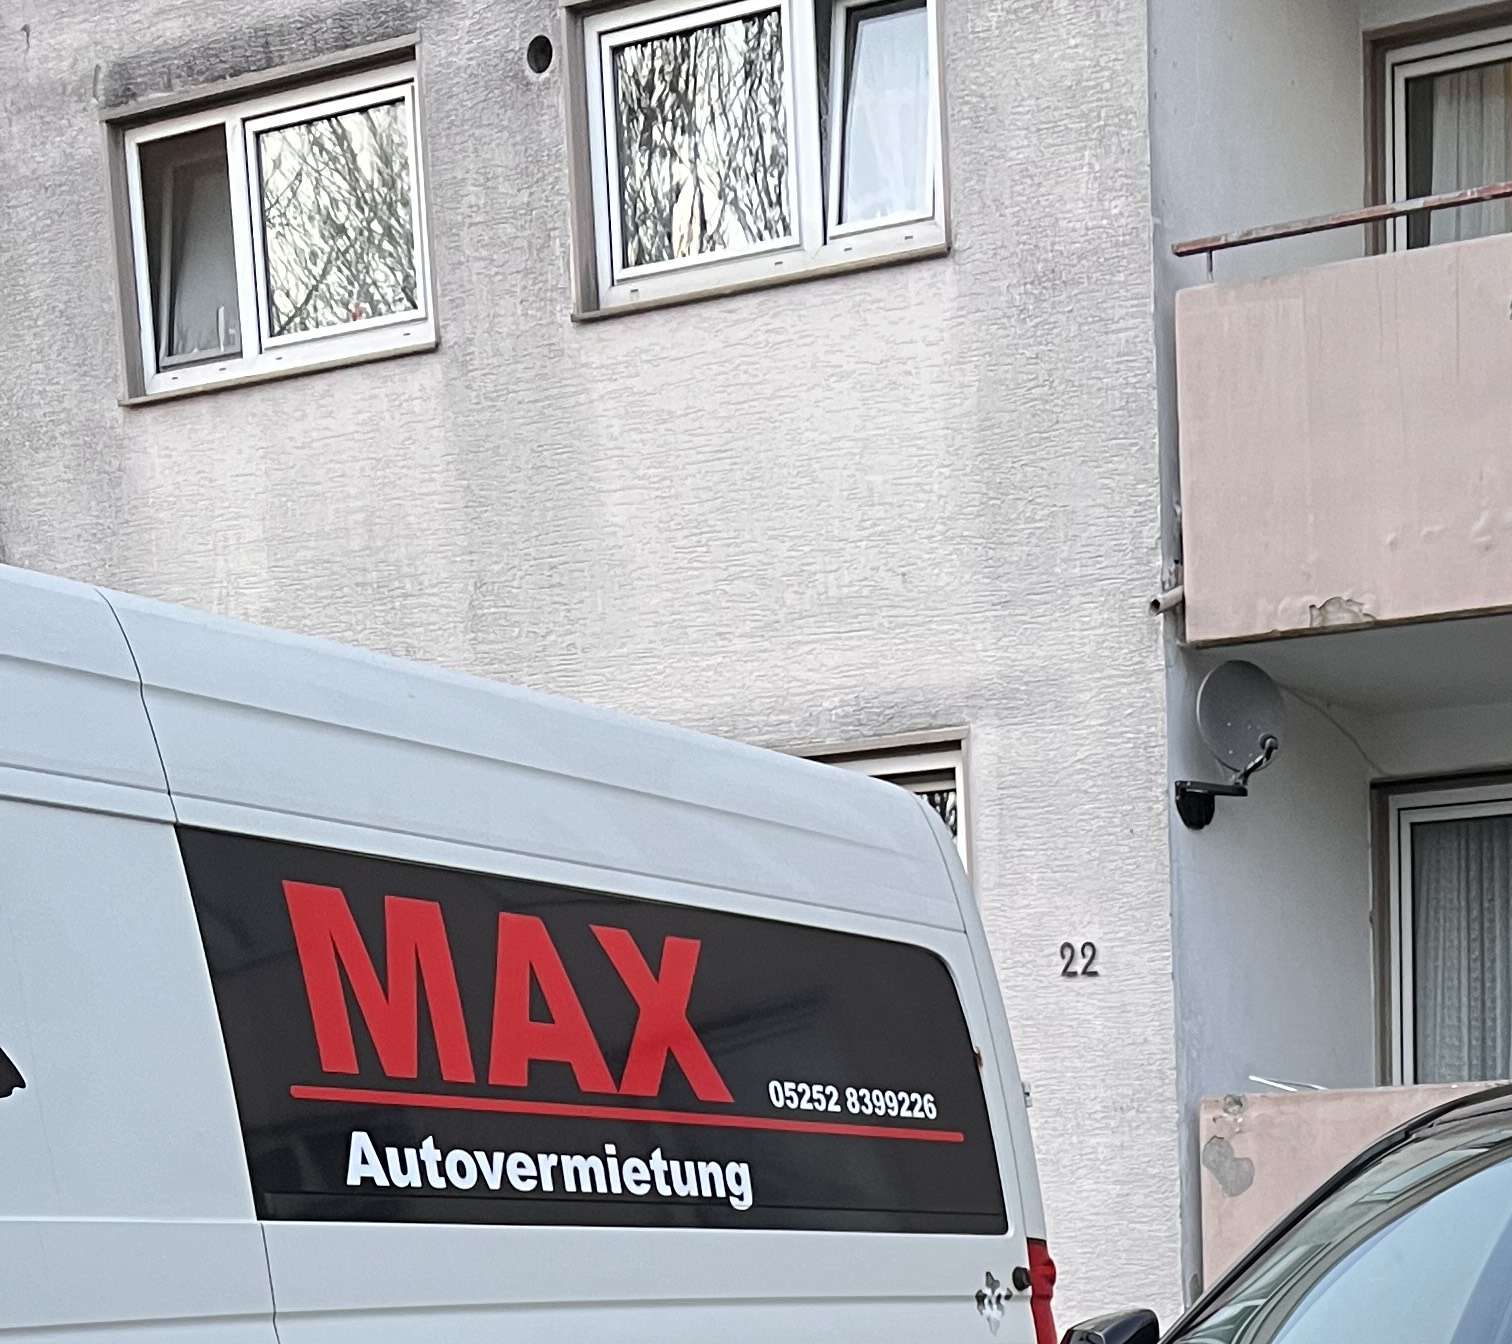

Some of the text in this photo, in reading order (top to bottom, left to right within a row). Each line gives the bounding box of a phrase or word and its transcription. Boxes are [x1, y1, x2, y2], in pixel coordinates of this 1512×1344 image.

[1060, 941, 1099, 977] 22
[281, 879, 734, 1103] MAX
[768, 1080, 937, 1120] 05252 8399226
[346, 1131, 752, 1211] Autovermietung
